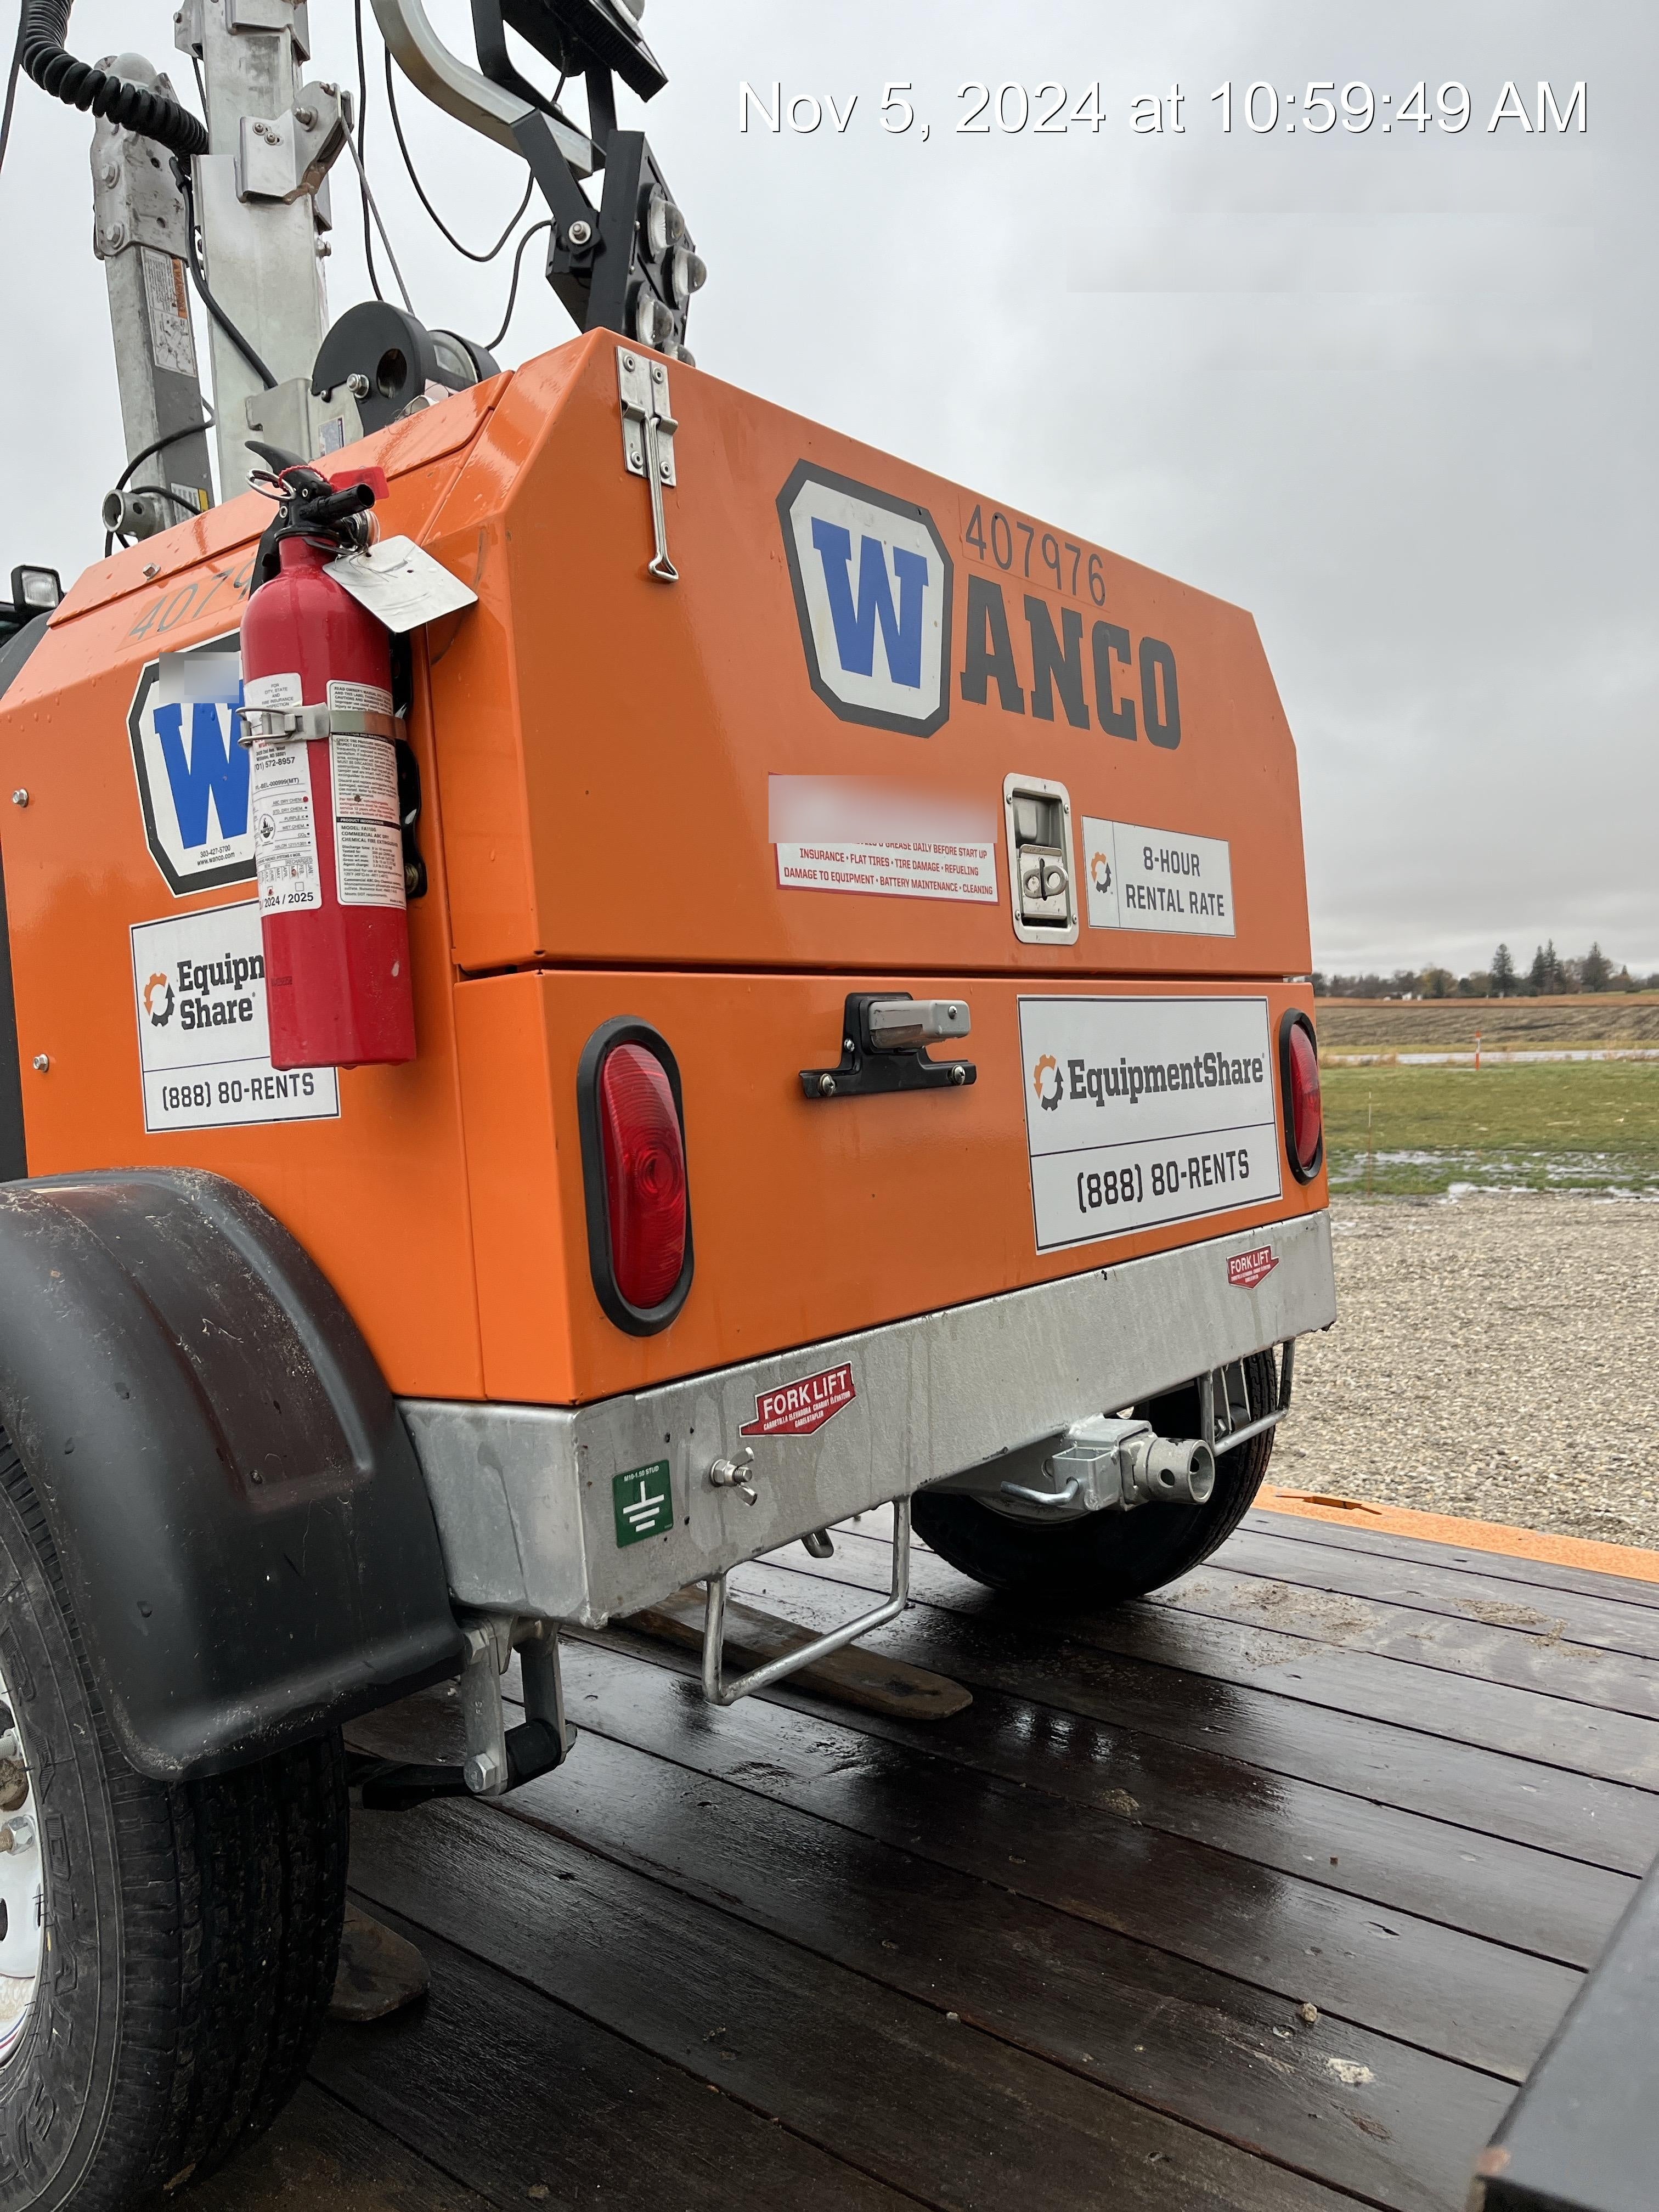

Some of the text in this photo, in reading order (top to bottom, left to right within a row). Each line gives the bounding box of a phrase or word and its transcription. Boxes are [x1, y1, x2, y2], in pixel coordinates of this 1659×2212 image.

[966, 504, 1105, 607] 407976
[266, 757, 295, 768] 572-8957
[197, 852, 235, 866] www.wanco.com
[200, 845, 230, 858] 303-427-5700
[800, 848, 979, 876] INSURANCE FLAT TIRES TIRE DAMAGE REFUELING
[913, 843, 932, 853] DAILY
[933, 845, 957, 856] BEFORE
[958, 848, 977, 858] START
[978, 849, 987, 859] UP
[1143, 847, 1200, 877] 8-HOUR
[784, 867, 993, 895] DAMAGE TO EQUIPMENT BATTERY MAINTENANCE CLEANING
[264, 895, 280, 908] 2024
[288, 892, 314, 904] 2025
[1125, 884, 1224, 916] RENTAL RATE
[180, 997, 253, 1030] Share
[162, 1072, 314, 1111] (888) 80-RENTS
[1068, 1052, 1263, 1107] EquipmentShare
[1077, 1149, 1249, 1213] (888) 80-RENTS
[1231, 1255, 1252, 1274] FORK
[1252, 1250, 1269, 1267] LIFT
[763, 1370, 847, 1420] FORK LIFT
[645, 1465, 659, 1477] STUD
